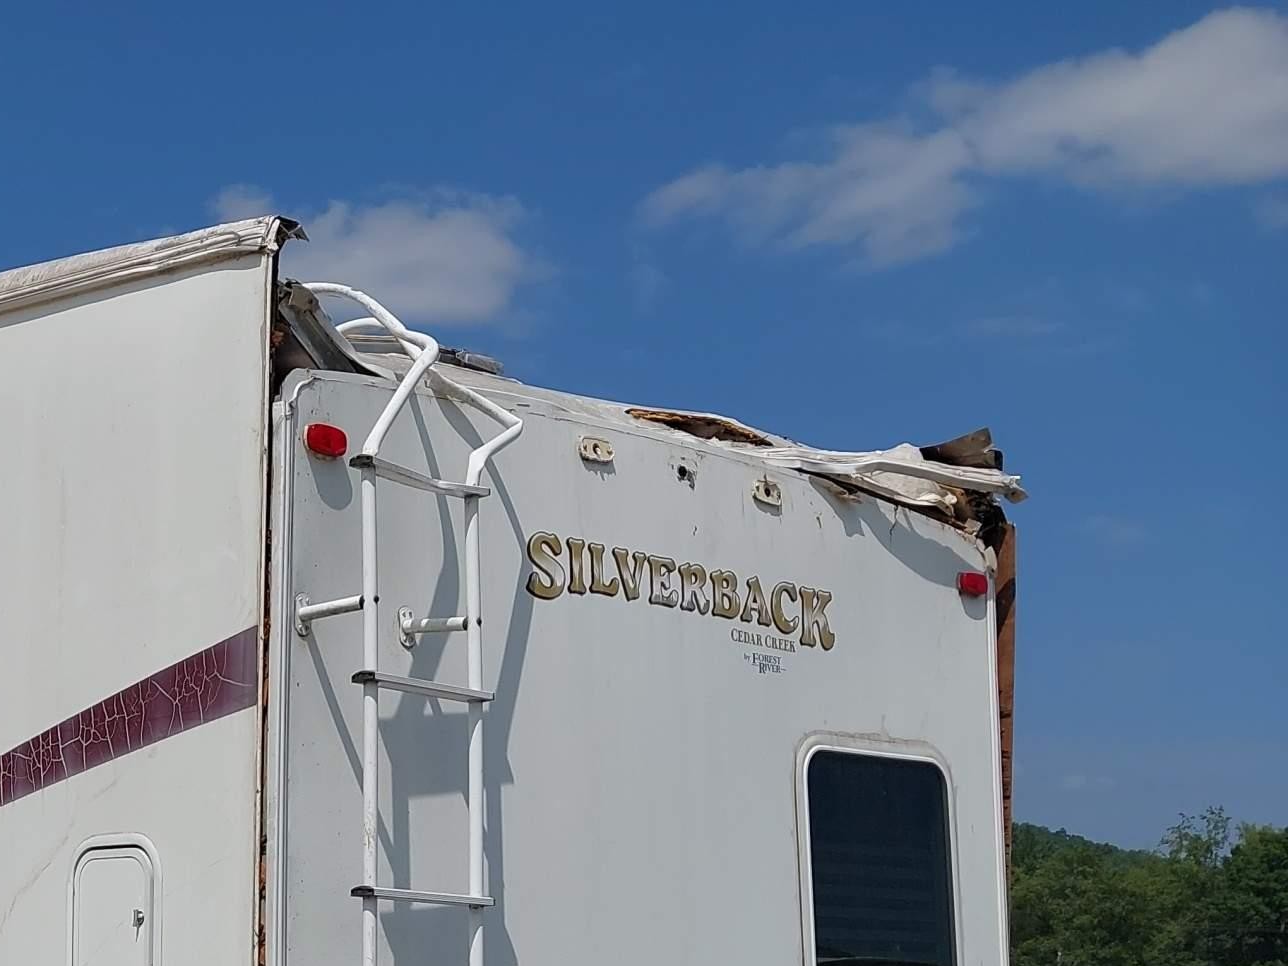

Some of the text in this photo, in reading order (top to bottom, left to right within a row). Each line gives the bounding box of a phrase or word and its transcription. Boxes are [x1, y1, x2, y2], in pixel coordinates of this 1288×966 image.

[526, 531, 835, 651] SILVERBACK
[731, 628, 796, 652] CEDAR CREEK
[752, 652, 782, 665] FOREST
[759, 662, 781, 674] RIVER
